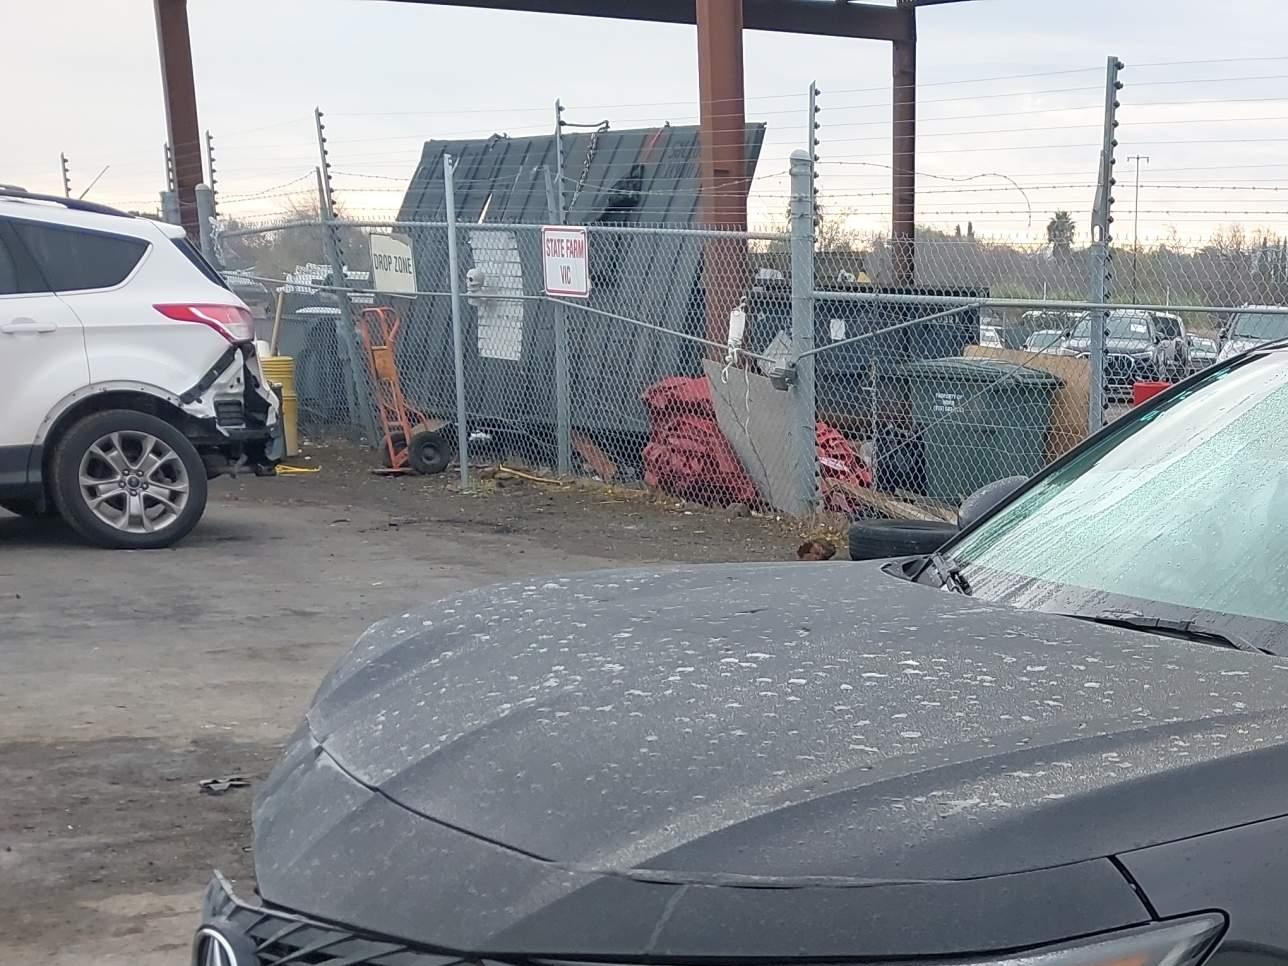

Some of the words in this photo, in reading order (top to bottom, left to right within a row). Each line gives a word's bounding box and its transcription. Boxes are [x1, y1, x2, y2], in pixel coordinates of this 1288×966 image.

[546, 237, 565, 258] STATE
[565, 238, 584, 259] FARM
[373, 253, 393, 271] DROP
[393, 255, 413, 275] ZONE
[560, 264, 572, 285] VIC
